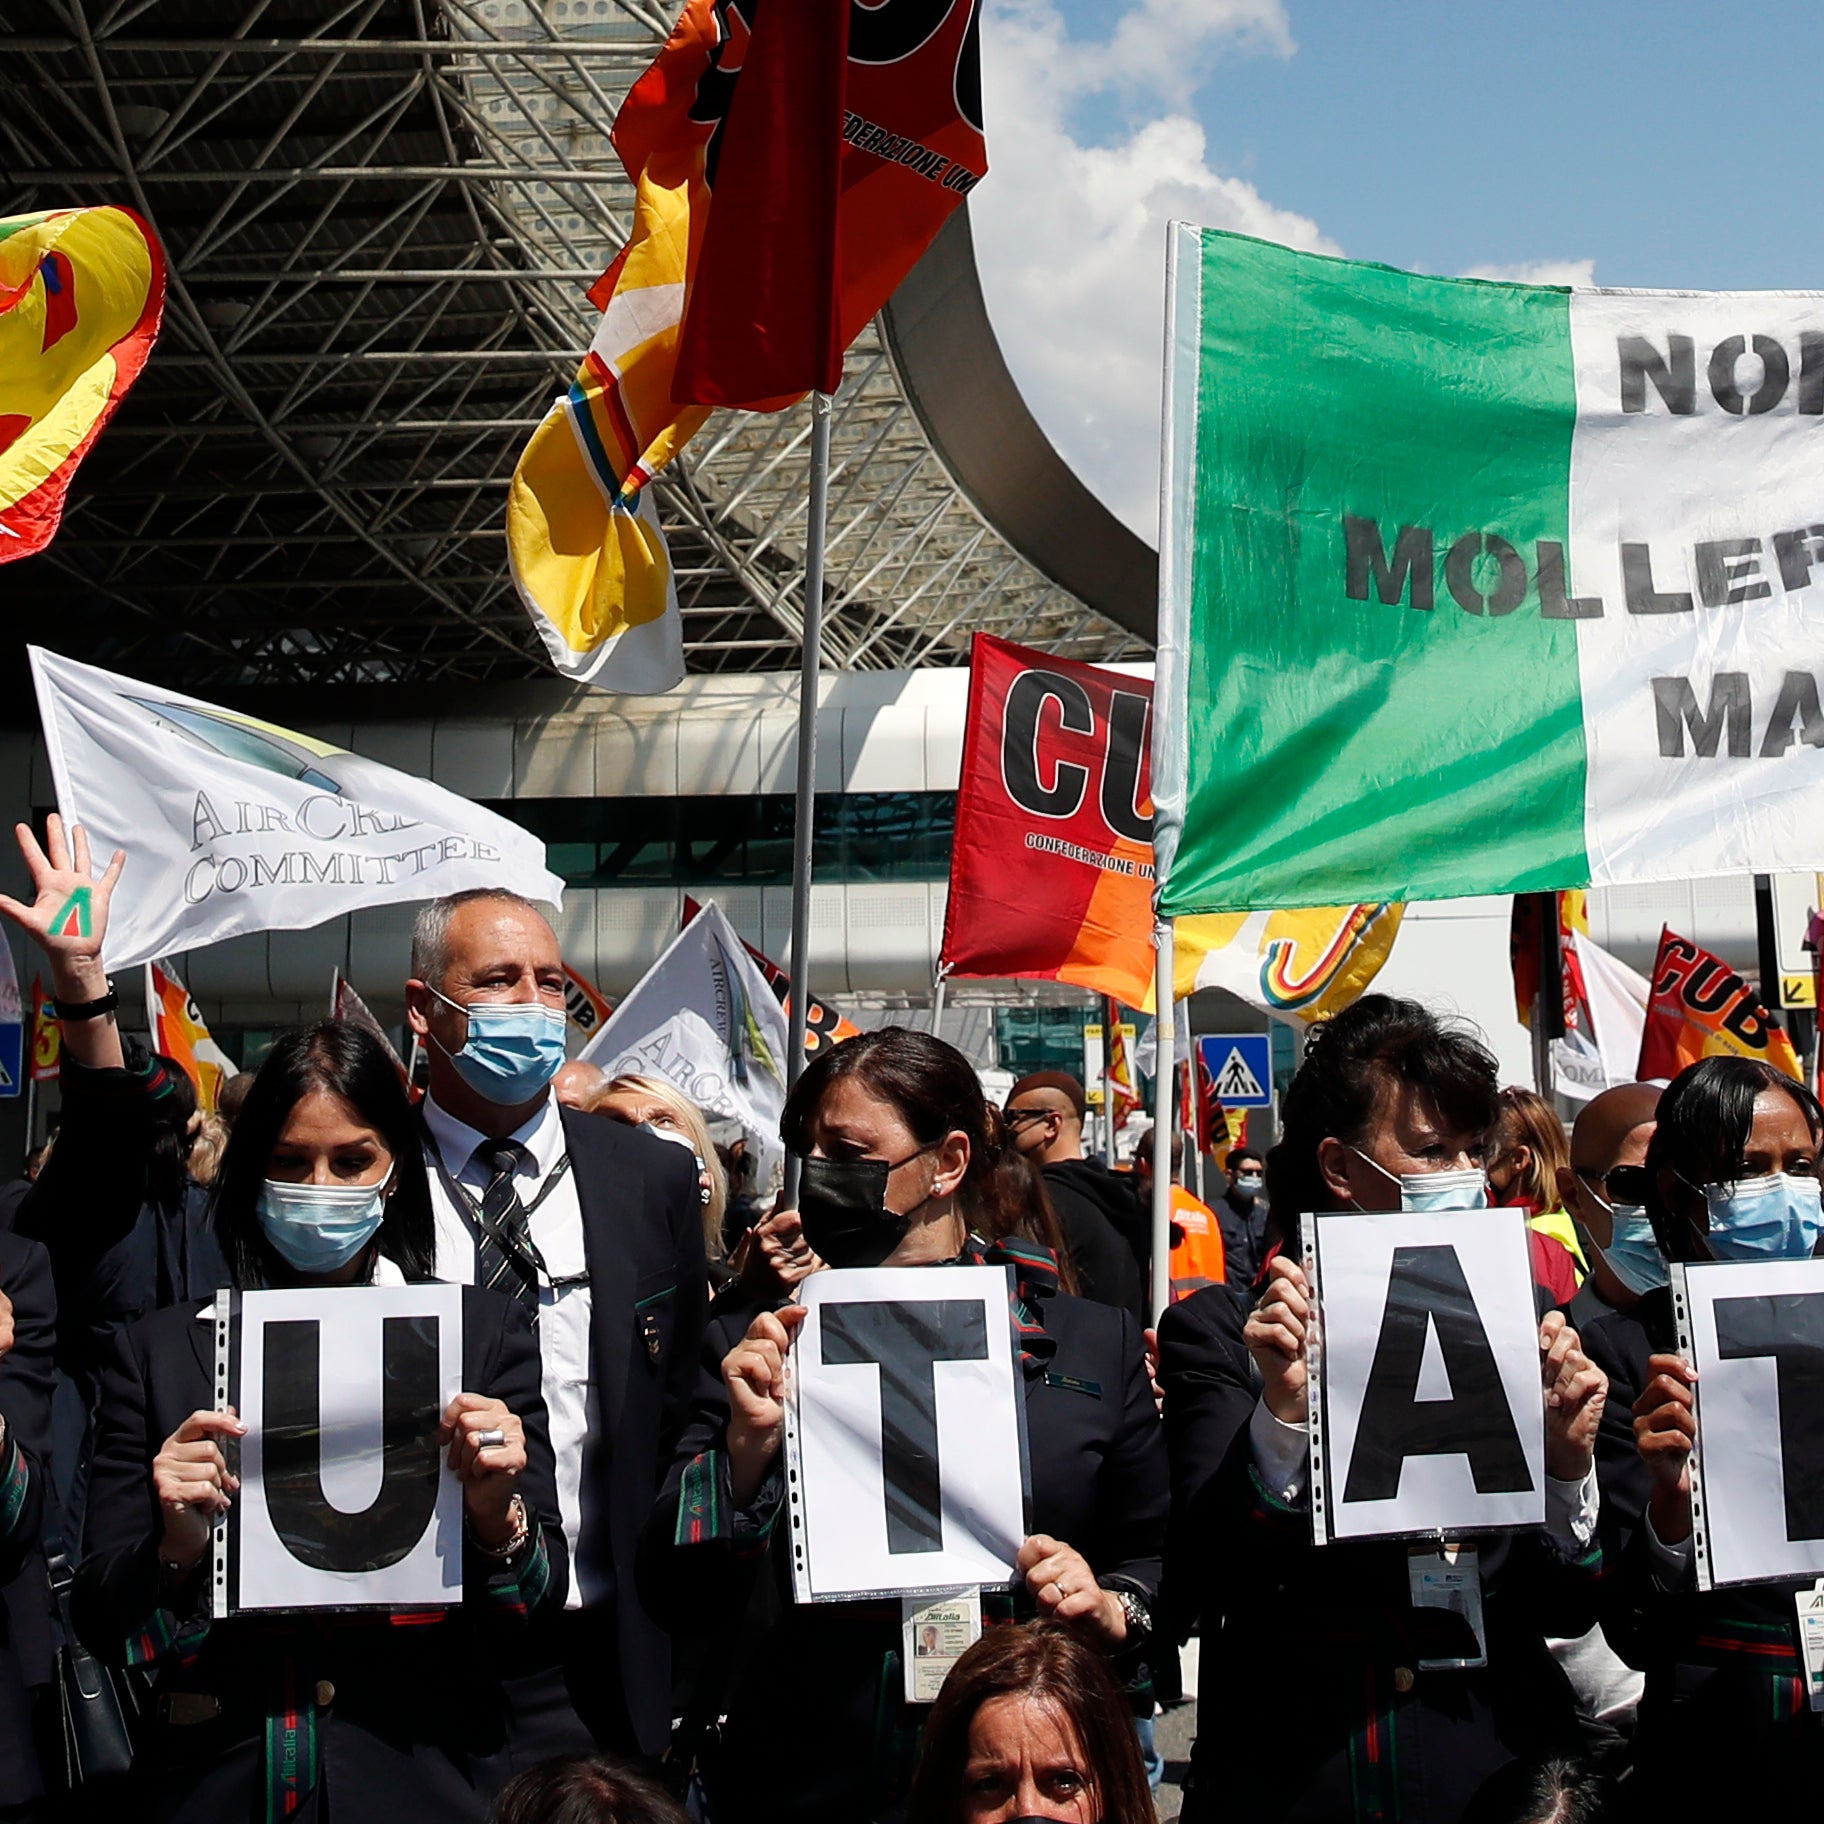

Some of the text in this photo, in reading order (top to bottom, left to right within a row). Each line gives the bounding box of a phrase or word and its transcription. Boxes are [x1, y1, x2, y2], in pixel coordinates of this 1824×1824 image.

[184, 833, 502, 905] COMMITTEE
[1025, 832, 1134, 876] CONFEDERAZIONE
[262, 1316, 440, 1572] U
[820, 1298, 989, 1555] T
[1342, 1244, 1535, 1504] A
[924, 1612, 961, 1622] Alitalia
